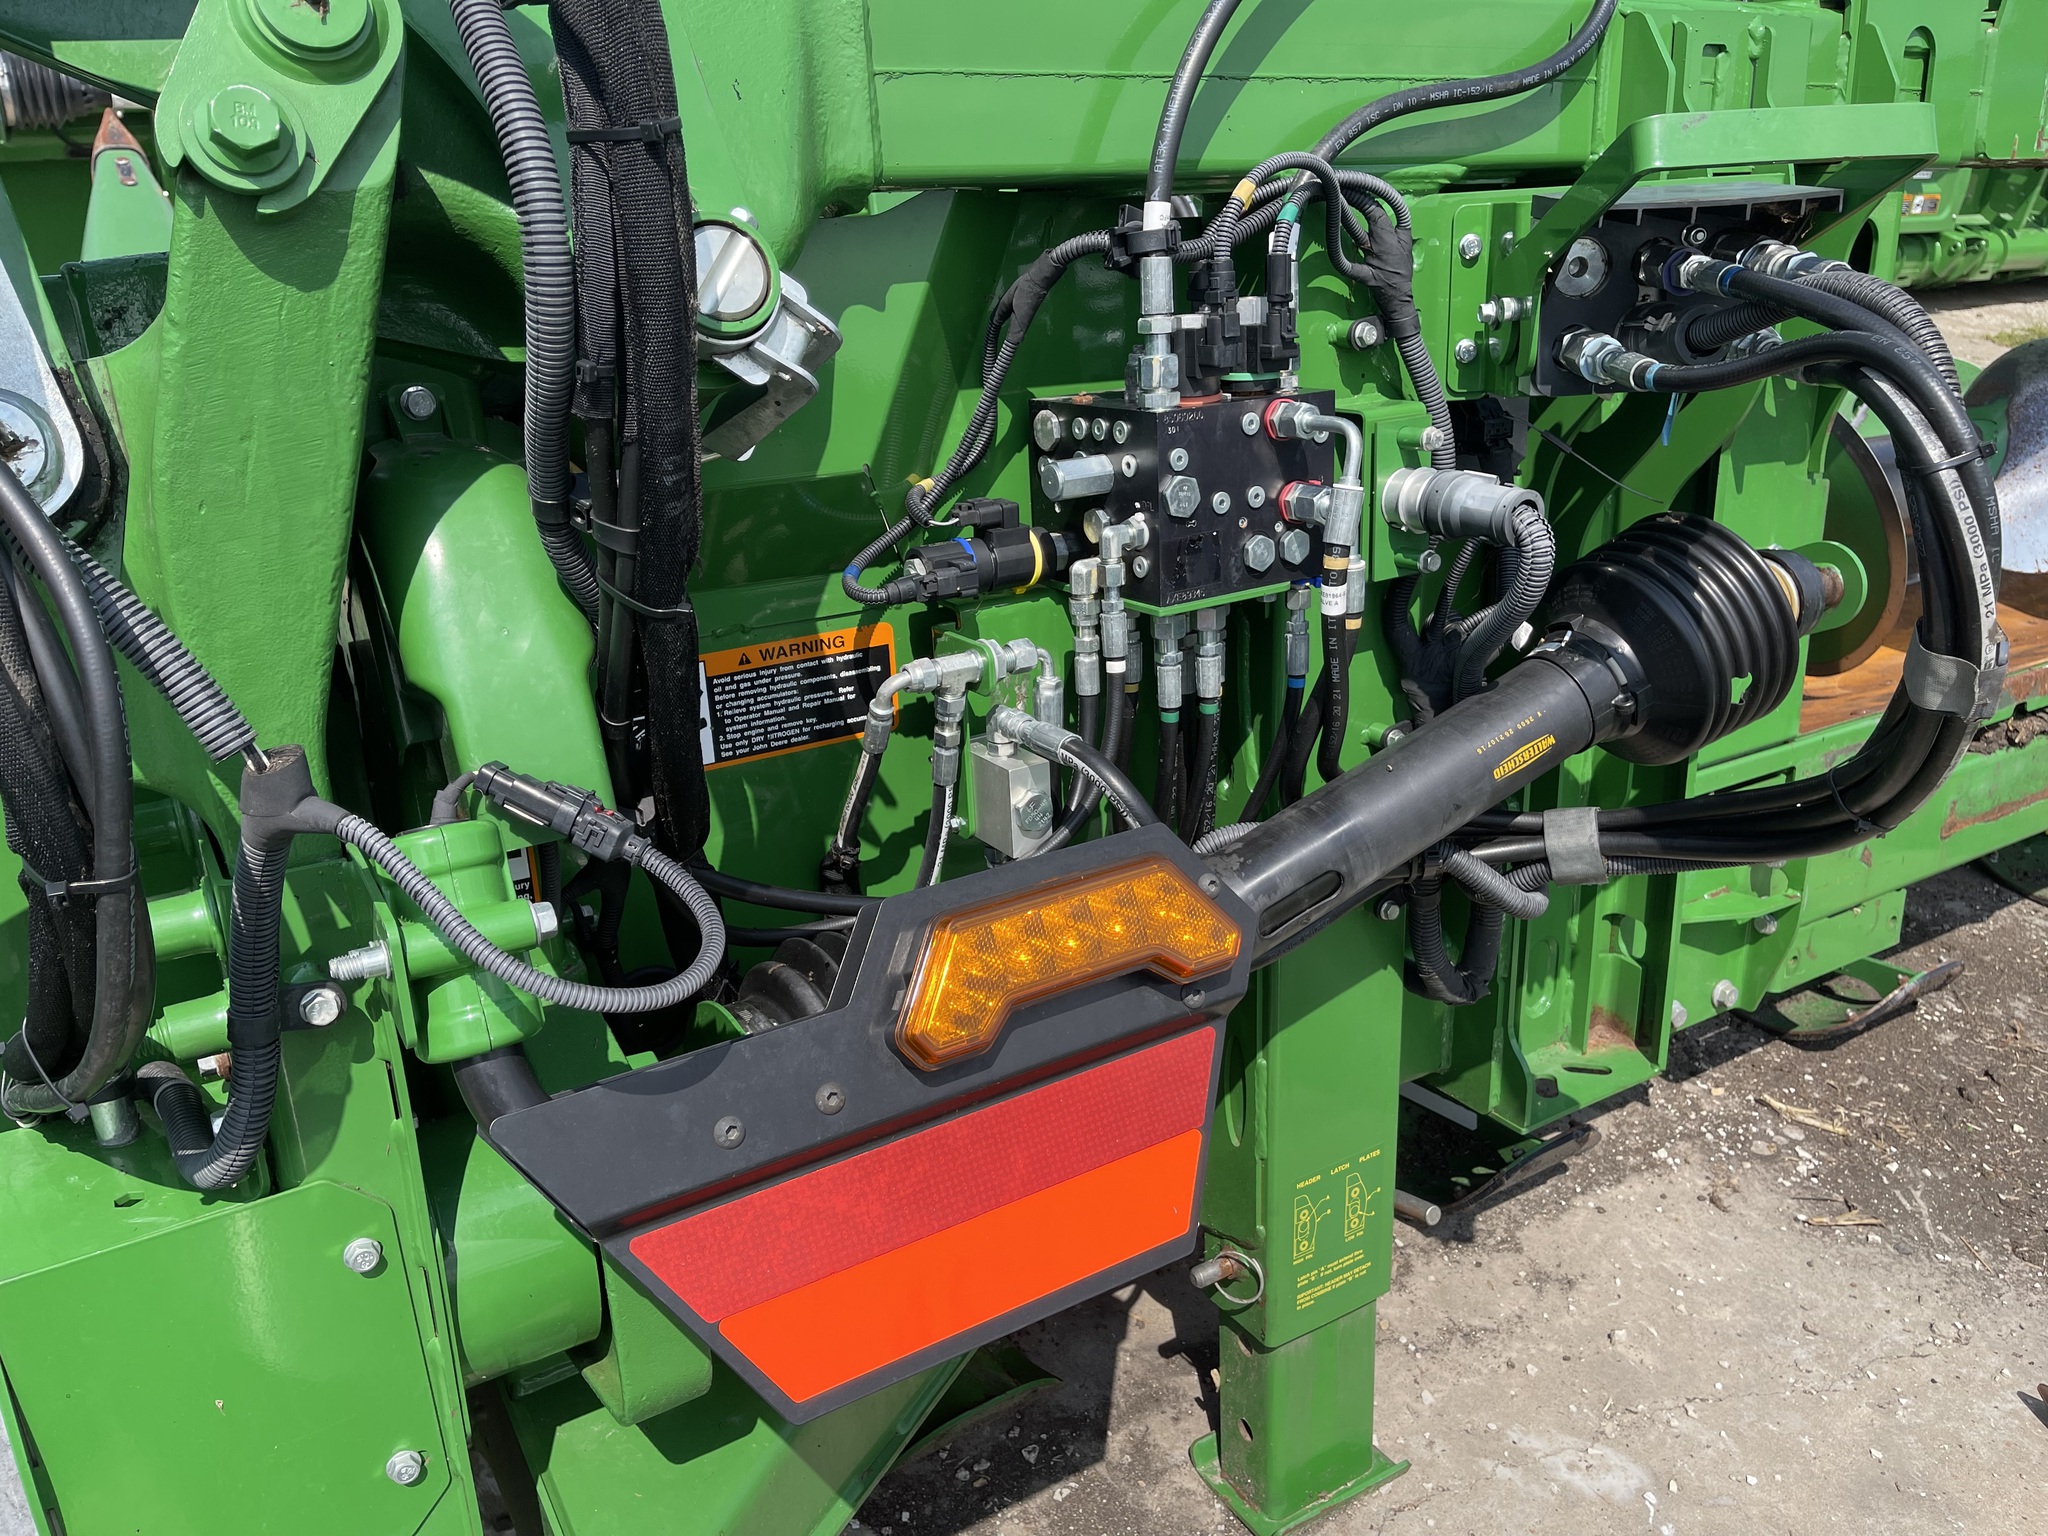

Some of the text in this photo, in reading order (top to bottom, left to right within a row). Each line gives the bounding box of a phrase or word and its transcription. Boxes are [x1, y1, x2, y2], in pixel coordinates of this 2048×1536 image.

[1335, 137, 1346, 150] EN
[1348, 123, 1362, 137] 857
[1366, 111, 1380, 124] 1SC
[1393, 102, 1403, 111] DN
[1408, 97, 1417, 106] 10
[1430, 90, 1449, 101] MSHA
[1453, 85, 1494, 97] IC-152/16
[1523, 73, 1540, 86] MADE
[1544, 69, 1553, 79] IN
[1556, 55, 1575, 71] ITALY
[1870, 334, 1892, 345] EN
[1957, 420, 1973, 439] DN
[1985, 495, 2000, 536] MSHA
[1951, 480, 1995, 618] 21 MPa (3000 PSI)
[1328, 617, 1336, 629] IT
[758, 635, 845, 661] WARNING
[1329, 638, 1338, 649] IN
[713, 676, 731, 685] Avoid
[733, 671, 757, 680] serious
[760, 668, 777, 676] injury
[797, 660, 818, 669] contact
[836, 652, 863, 662] hydraulic
[754, 678, 772, 686] under
[775, 673, 802, 682] pressure.
[1331, 657, 1340, 683] MADE
[715, 665, 881, 701] Before removing hydraulic components, disassembling
[1333, 690, 1341, 699] 21
[724, 706, 746, 716] Relieve
[749, 701, 771, 711] system
[774, 695, 801, 708] hydraulic
[804, 691, 834, 701] pressures.
[839, 685, 855, 693] Refer
[725, 696, 755, 708] changing
[757, 689, 799, 702] accumulators:
[734, 712, 761, 723] Operator
[764, 706, 786, 716] Manual
[802, 700, 822, 709] Repair
[824, 695, 845, 704] Manual
[726, 715, 786, 732] system information.
[727, 732, 741, 740] Stop
[744, 727, 764, 737] engine
[781, 720, 803, 729] remove
[735, 738, 748, 747] only
[752, 735, 764, 743] DRY
[767, 728, 800, 740] NITROGEN
[814, 719, 845, 731] recharging
[847, 715, 868, 723] accum
[736, 747, 749, 755] your
[753, 743, 768, 752] John
[770, 739, 788, 747] Deere
[790, 734, 810, 743] dealer.
[1493, 735, 1555, 779] WALTERSCHEID
[1081, 767, 1106, 793] (3000
[515, 882, 530, 890] ury
[1297, 1149, 1380, 1189] HEADER LATCH PLATES
[1297, 1280, 1308, 1288] plate
[1343, 1259, 1353, 1267] plate
[1297, 1285, 1324, 1299] IMPORTANT:
[1325, 1275, 1343, 1287] HEADER
[1353, 1262, 1371, 1273] DETACH
[1298, 1273, 1310, 1282] Latch
[1327, 1260, 1338, 1268] must
[1339, 1253, 1353, 1263] extend
[1297, 1296, 1310, 1305] FROM
[1311, 1286, 1331, 1298] COMBINE
[1336, 1280, 1346, 1288] plate
[1302, 1300, 1315, 1309] place.
